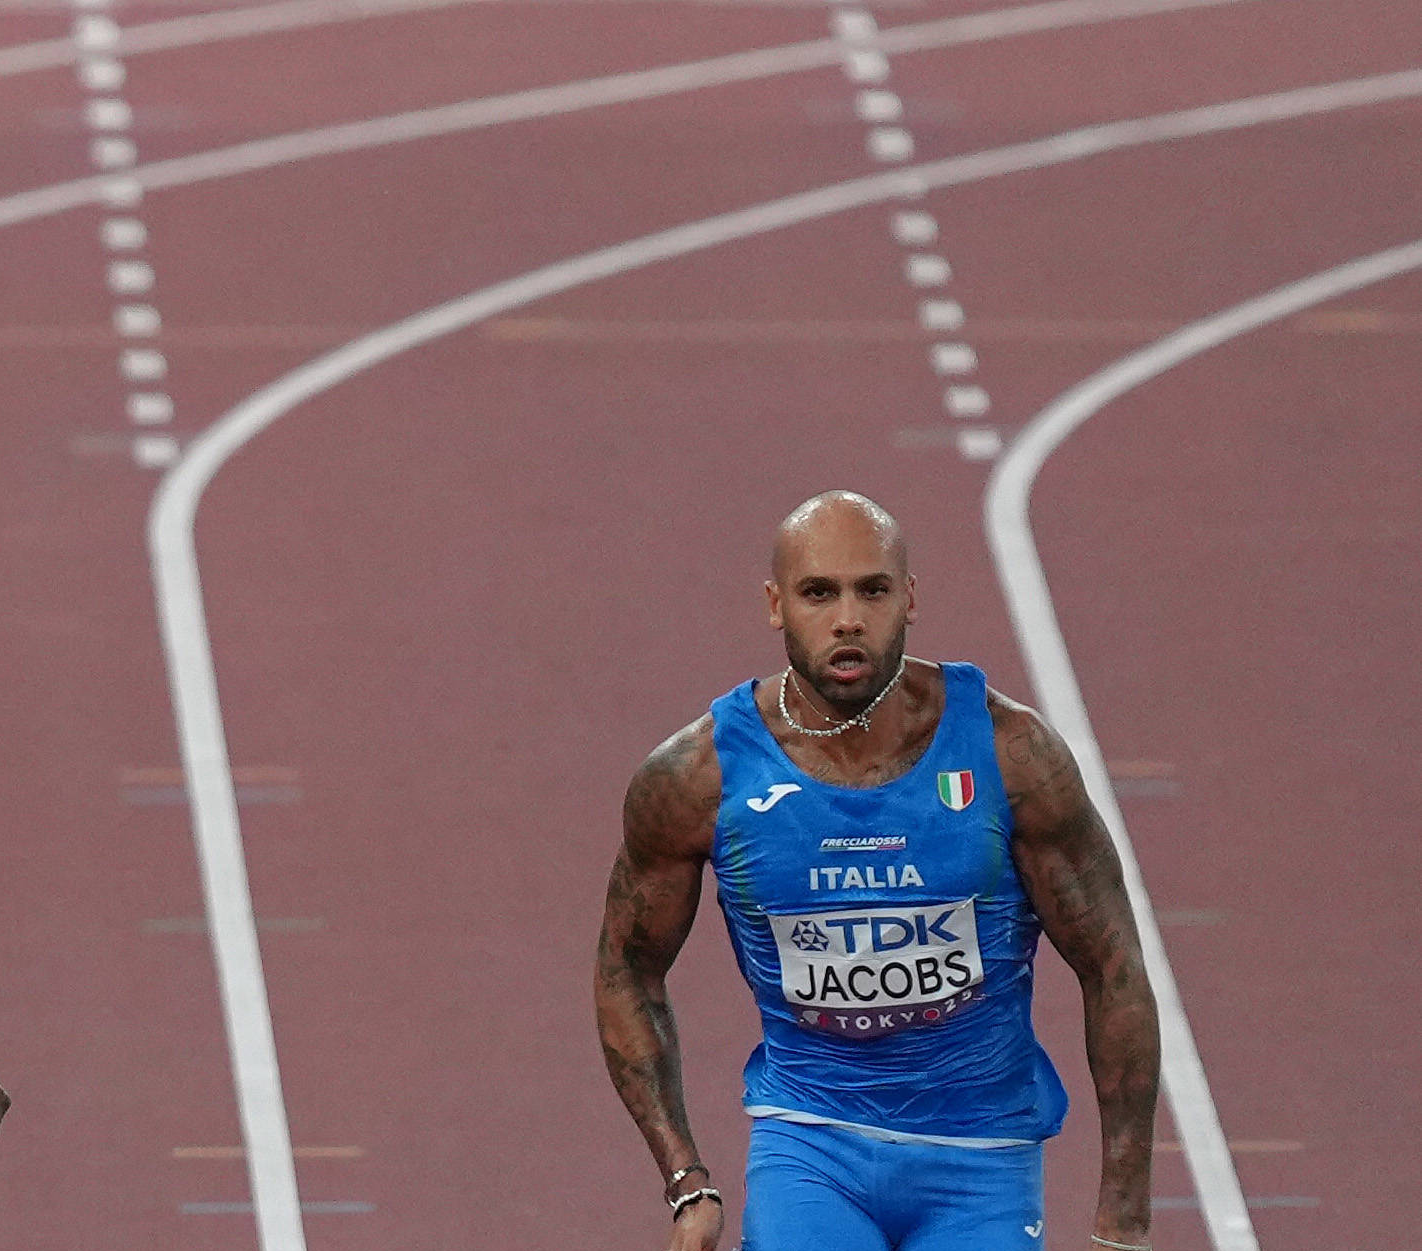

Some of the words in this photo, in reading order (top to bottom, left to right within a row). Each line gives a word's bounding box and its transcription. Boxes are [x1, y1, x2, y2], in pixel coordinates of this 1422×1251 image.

[820, 836, 907, 847] FRECCIAROSSA
[809, 864, 925, 890] ITALIA
[825, 909, 962, 954] TDK
[795, 950, 972, 1001] JACOBS
